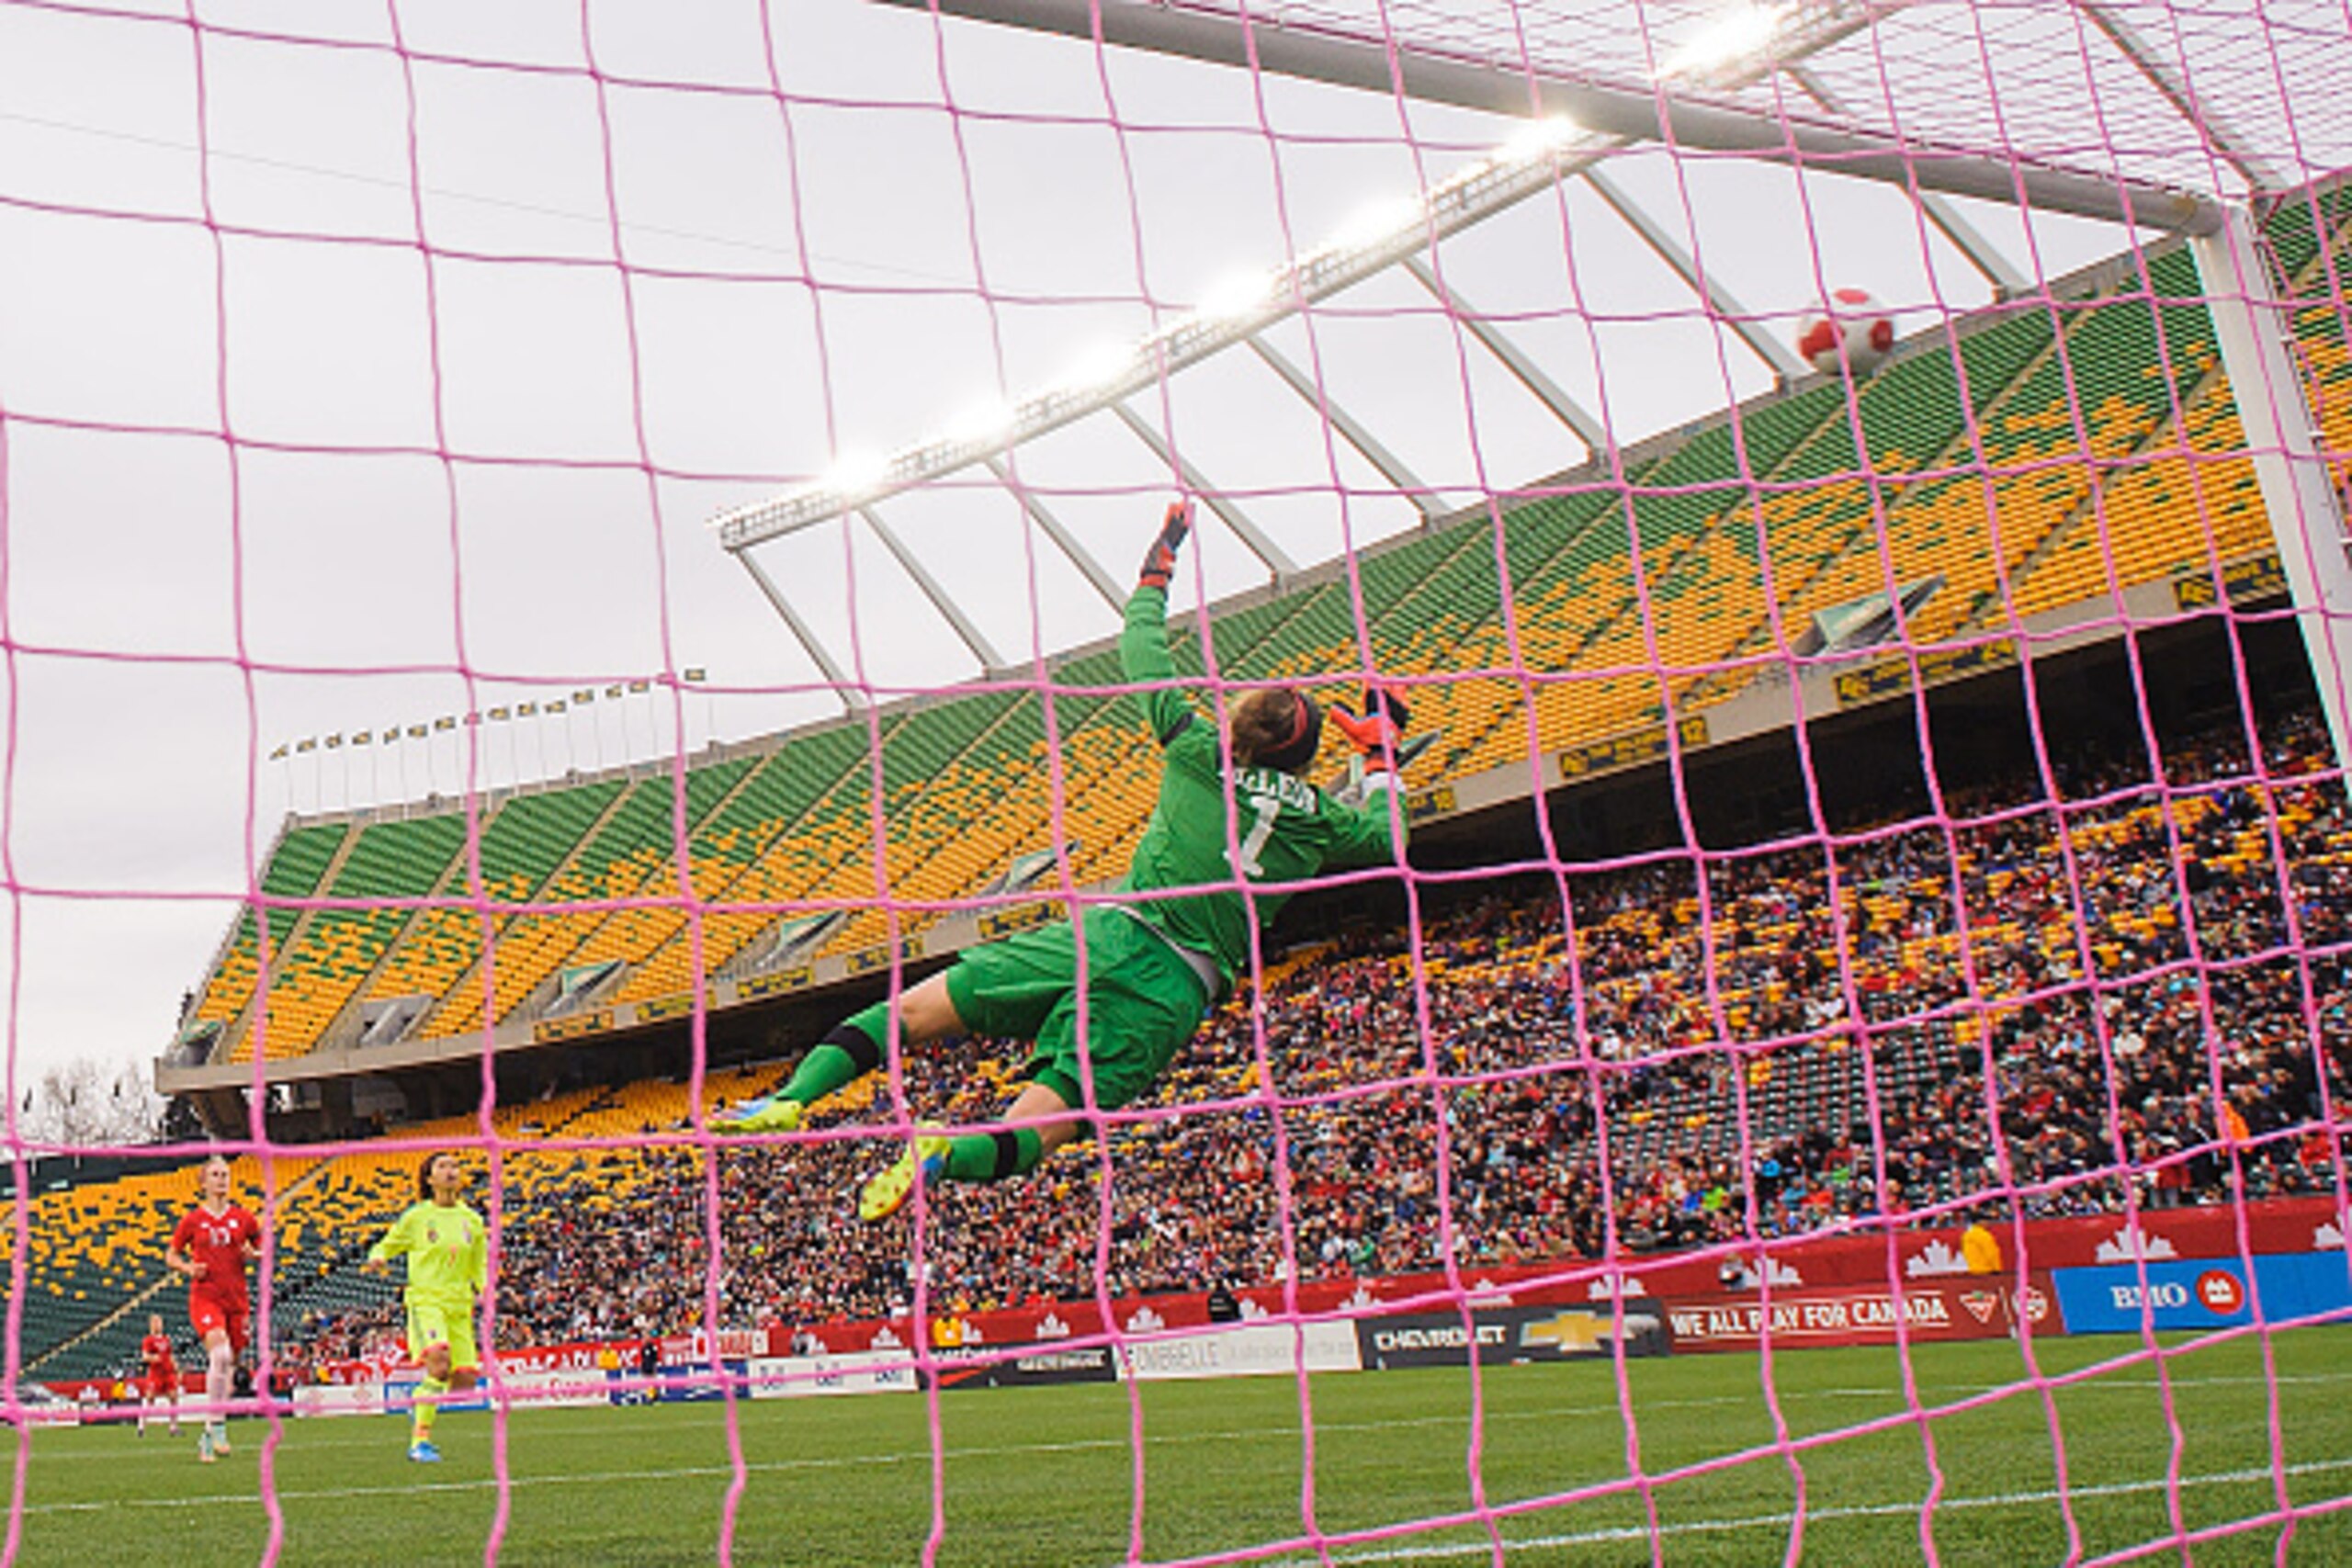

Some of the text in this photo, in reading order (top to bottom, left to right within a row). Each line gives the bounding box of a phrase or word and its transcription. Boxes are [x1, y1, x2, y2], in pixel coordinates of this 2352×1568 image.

[2109, 1282, 2189, 1309] BMO
[1669, 1312, 1705, 1336] WE
[1709, 1310, 1747, 1334] ALL
[1804, 1304, 1849, 1328] FOR
[1851, 1297, 1950, 1325] CANADA
[1374, 1325, 1508, 1351] CHEVROET
